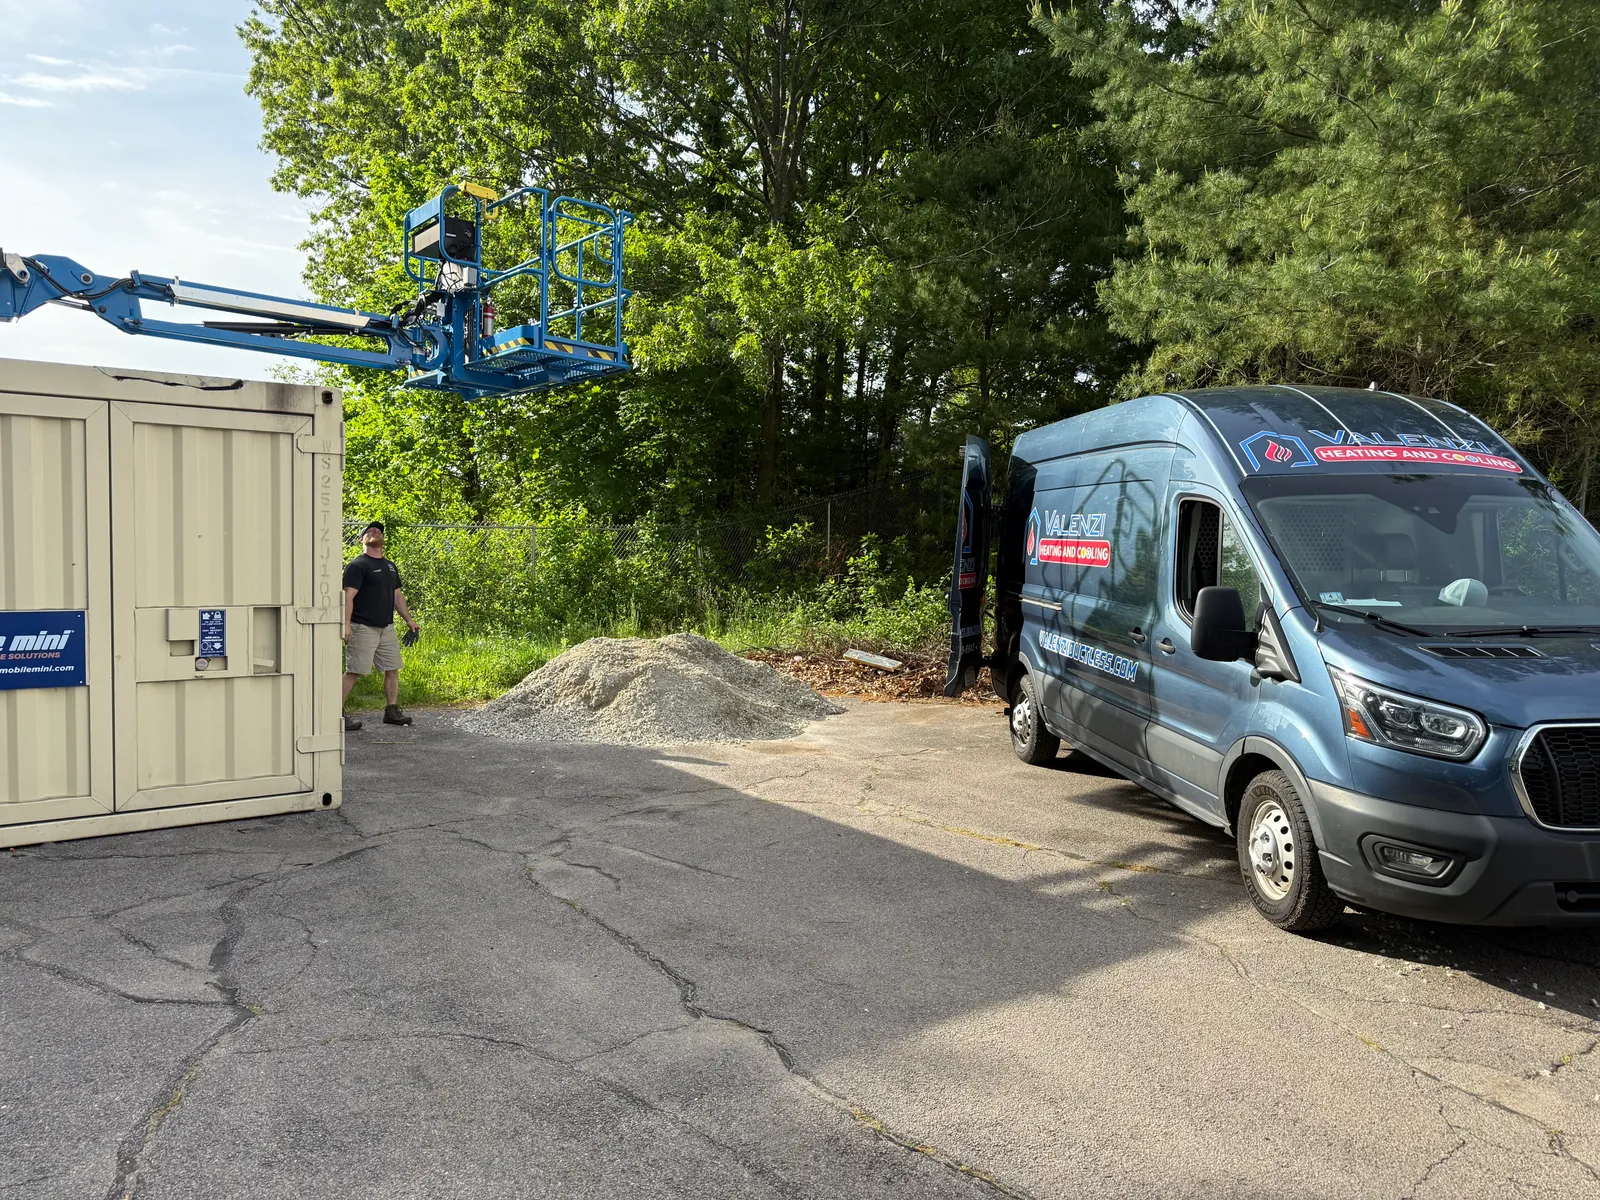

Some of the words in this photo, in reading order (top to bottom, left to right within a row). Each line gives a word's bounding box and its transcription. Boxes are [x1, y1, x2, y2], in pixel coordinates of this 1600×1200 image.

[1308, 429, 1493, 454] VALENZI
[1320, 449, 1398, 459] HEATING
[1402, 450, 1438, 459] AND
[1441, 452, 1517, 470] COOLING
[1045, 509, 1107, 537] VALENZI
[1040, 544, 1062, 558] HEATING
[1062, 545, 1076, 558] AND
[1077, 546, 1108, 561] COOLING
[9, 630, 72, 651] mini
[8, 652, 61, 660] SOLUTIONS
[1039, 629, 1139, 683] VALENZIDUCTLESS.COM
